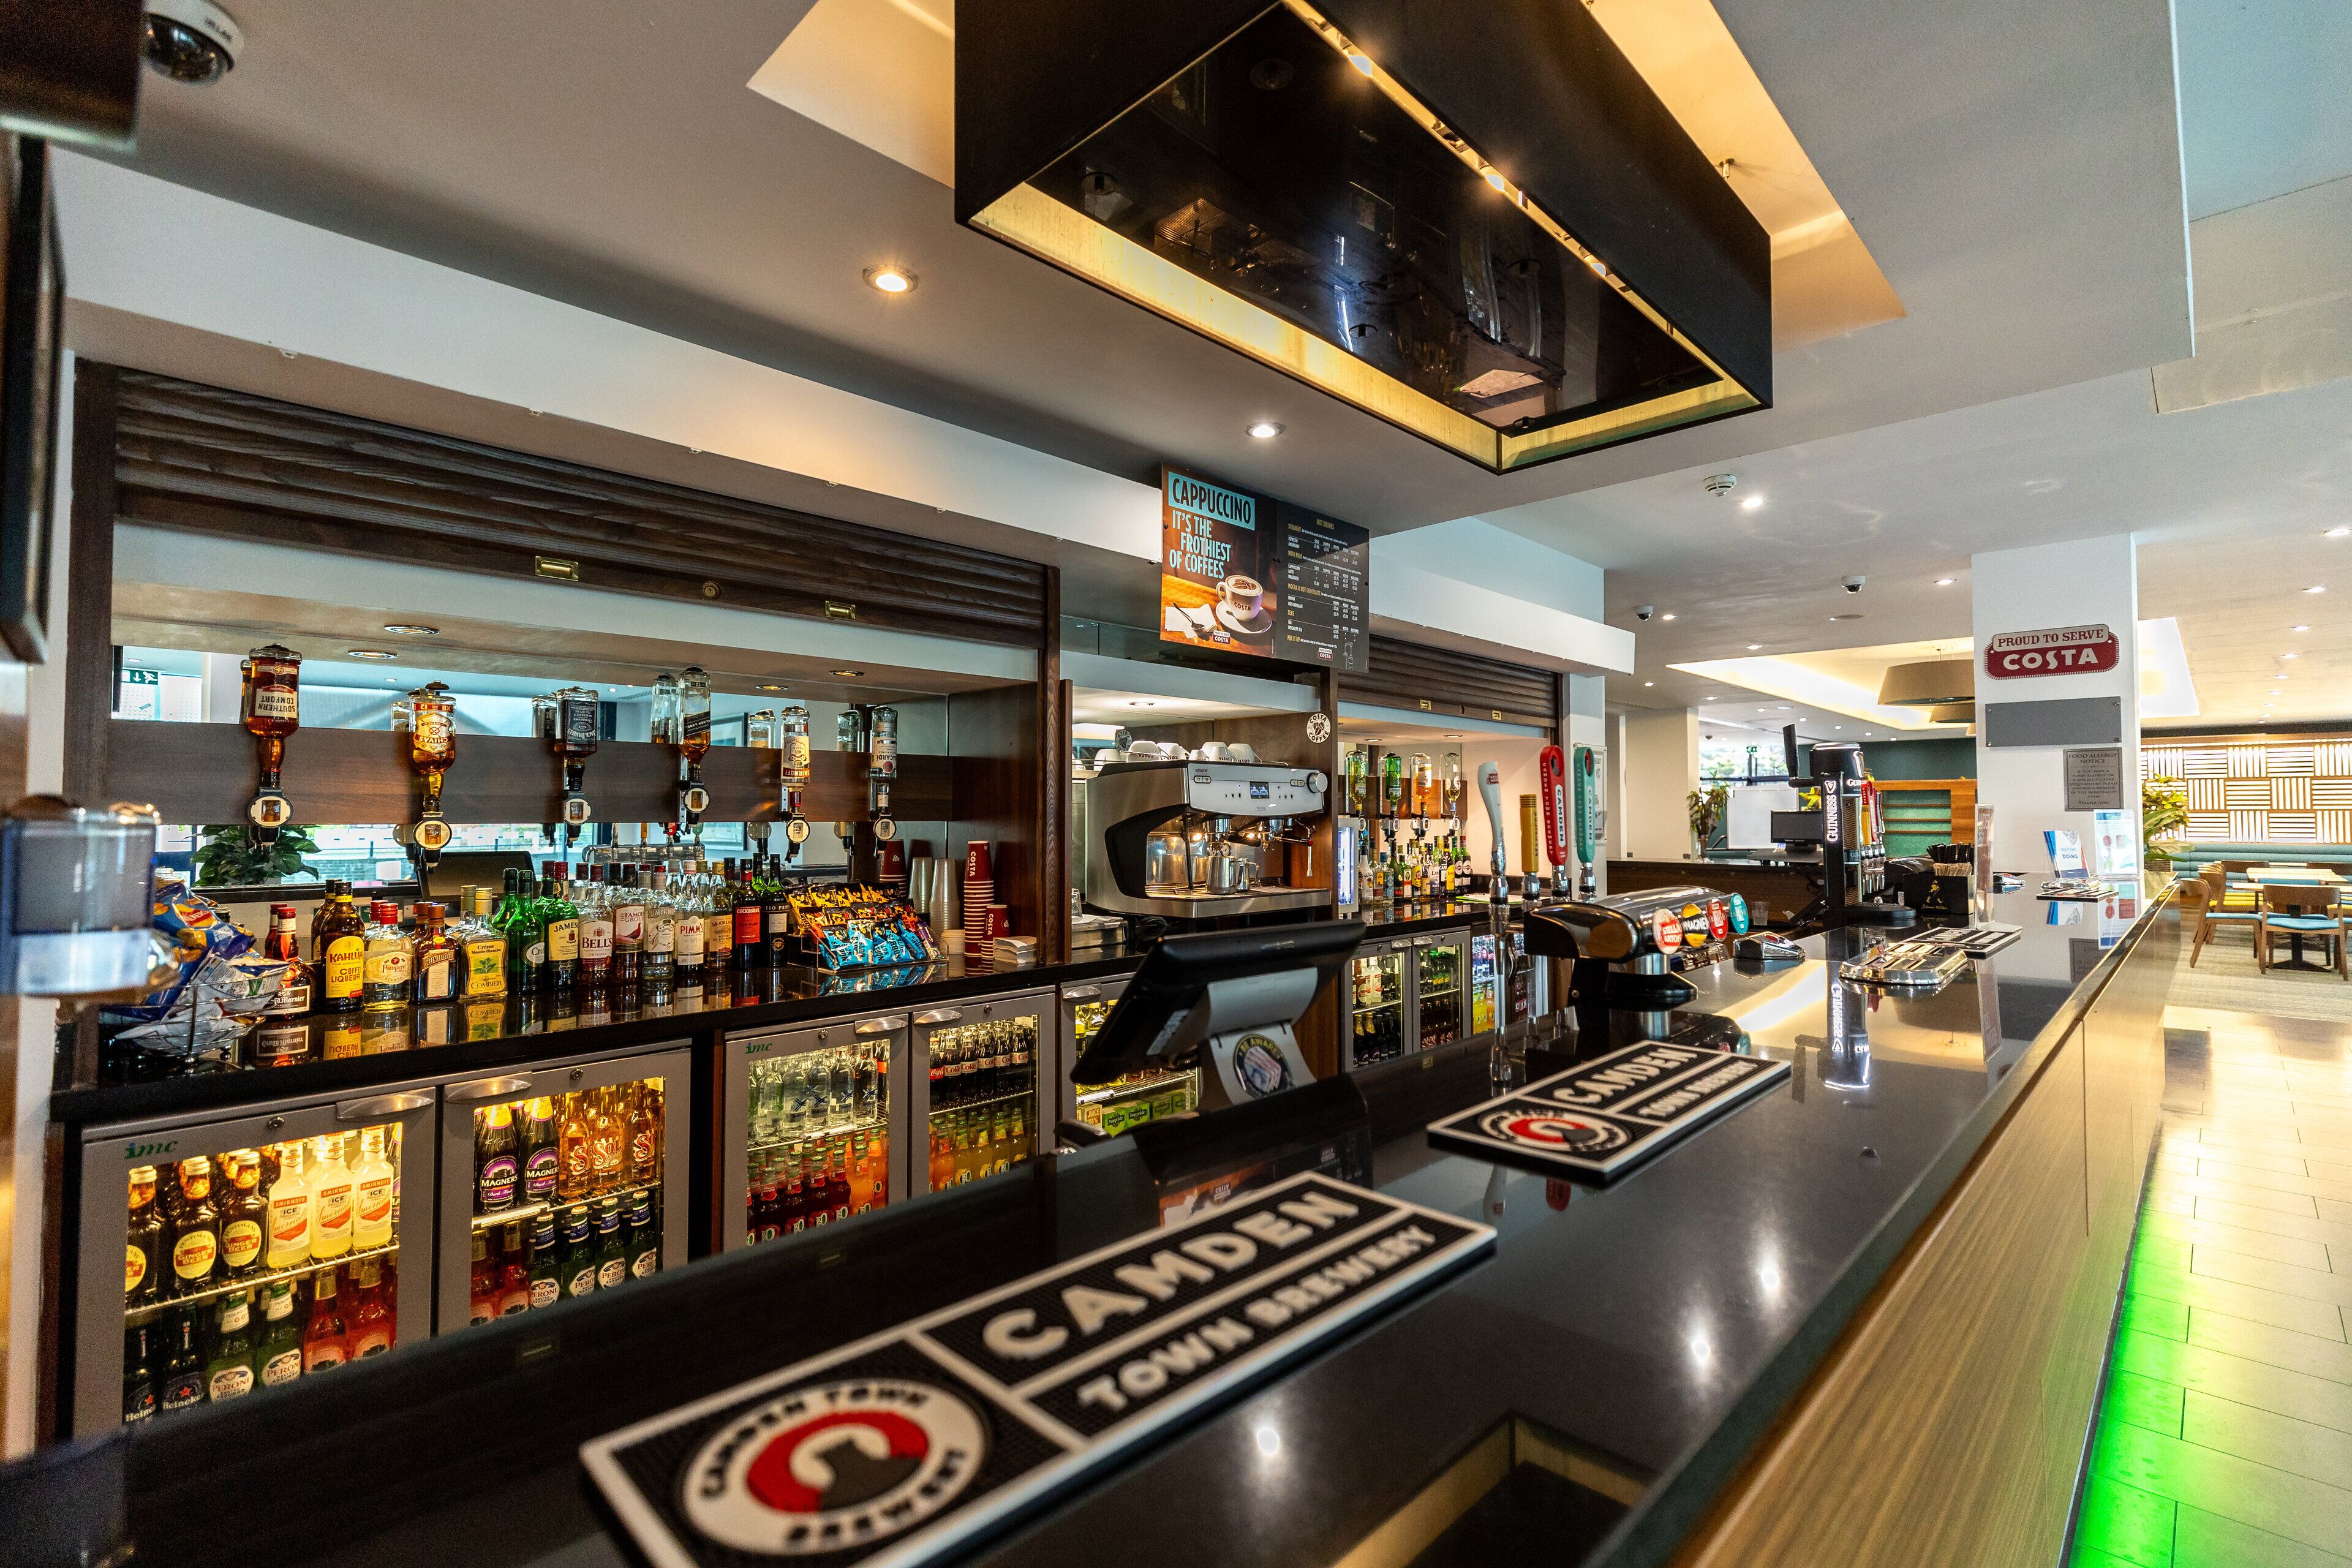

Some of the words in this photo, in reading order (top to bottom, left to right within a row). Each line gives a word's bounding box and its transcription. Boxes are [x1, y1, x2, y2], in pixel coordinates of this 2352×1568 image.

[1172, 478, 1251, 524] CAPPUCCINO
[1172, 510, 1192, 532] IT'S
[1194, 516, 1212, 538] THE
[1180, 532, 1231, 562] FROTHIEST
[1169, 549, 1183, 569] OF
[1185, 553, 1224, 579] COFFEES
[1234, 602, 1251, 611] COSTA
[1997, 635, 2040, 648] PROUD
[2043, 633, 2059, 643] TO
[2062, 629, 2104, 642] SERVE
[2003, 648, 2098, 670] COSTA
[260, 696, 294, 704] COMFORT
[258, 703, 296, 712] SOUTHERN
[1310, 714, 1327, 723] COSTA
[567, 728, 585, 739] DANIEL'S
[1309, 731, 1329, 742] COFFEE
[1826, 794, 1838, 843] GUINNESS
[554, 922, 579, 932] JAMES
[680, 922, 704, 935] PIMM'S
[1662, 923, 1681, 934] STELLA
[582, 937, 612, 948] BELL'S
[1664, 934, 1681, 943] ARTOIS
[330, 948, 363, 963] KAHLÚA
[424, 951, 454, 967] COINTREAU
[382, 964, 406, 973] Pampero
[331, 973, 360, 982] LIQUEUR
[470, 981, 502, 990] COMBIER
[280, 995, 306, 1004] Marnier
[745, 1042, 773, 1054] imc
[1553, 1047, 1698, 1102] CAMDEN
[1638, 1089, 1701, 1117] TOWN
[1088, 1107, 1099, 1117] JUICE
[1129, 1110, 1147, 1118] Sunpride
[125, 1140, 179, 1160] imc
[362, 1179, 390, 1189] SMIRNOFF
[481, 1174, 518, 1187] MAGNERS
[323, 1186, 350, 1196] SMIRNOFF
[275, 1197, 306, 1207] SMIRNOFF
[225, 1238, 257, 1248] GINGER
[178, 1248, 213, 1261] GINGER
[228, 1245, 253, 1253] BEER
[183, 1255, 208, 1265] BEER
[638, 1259, 655, 1270] PERO
[982, 1190, 1359, 1359] CAMDEN
[575, 1278, 594, 1288] PERO
[530, 1287, 557, 1297] PERONI
[1077, 1316, 1254, 1409] TOWN
[1243, 1224, 1436, 1328] BREWERY
[213, 1377, 249, 1392] PERONI
